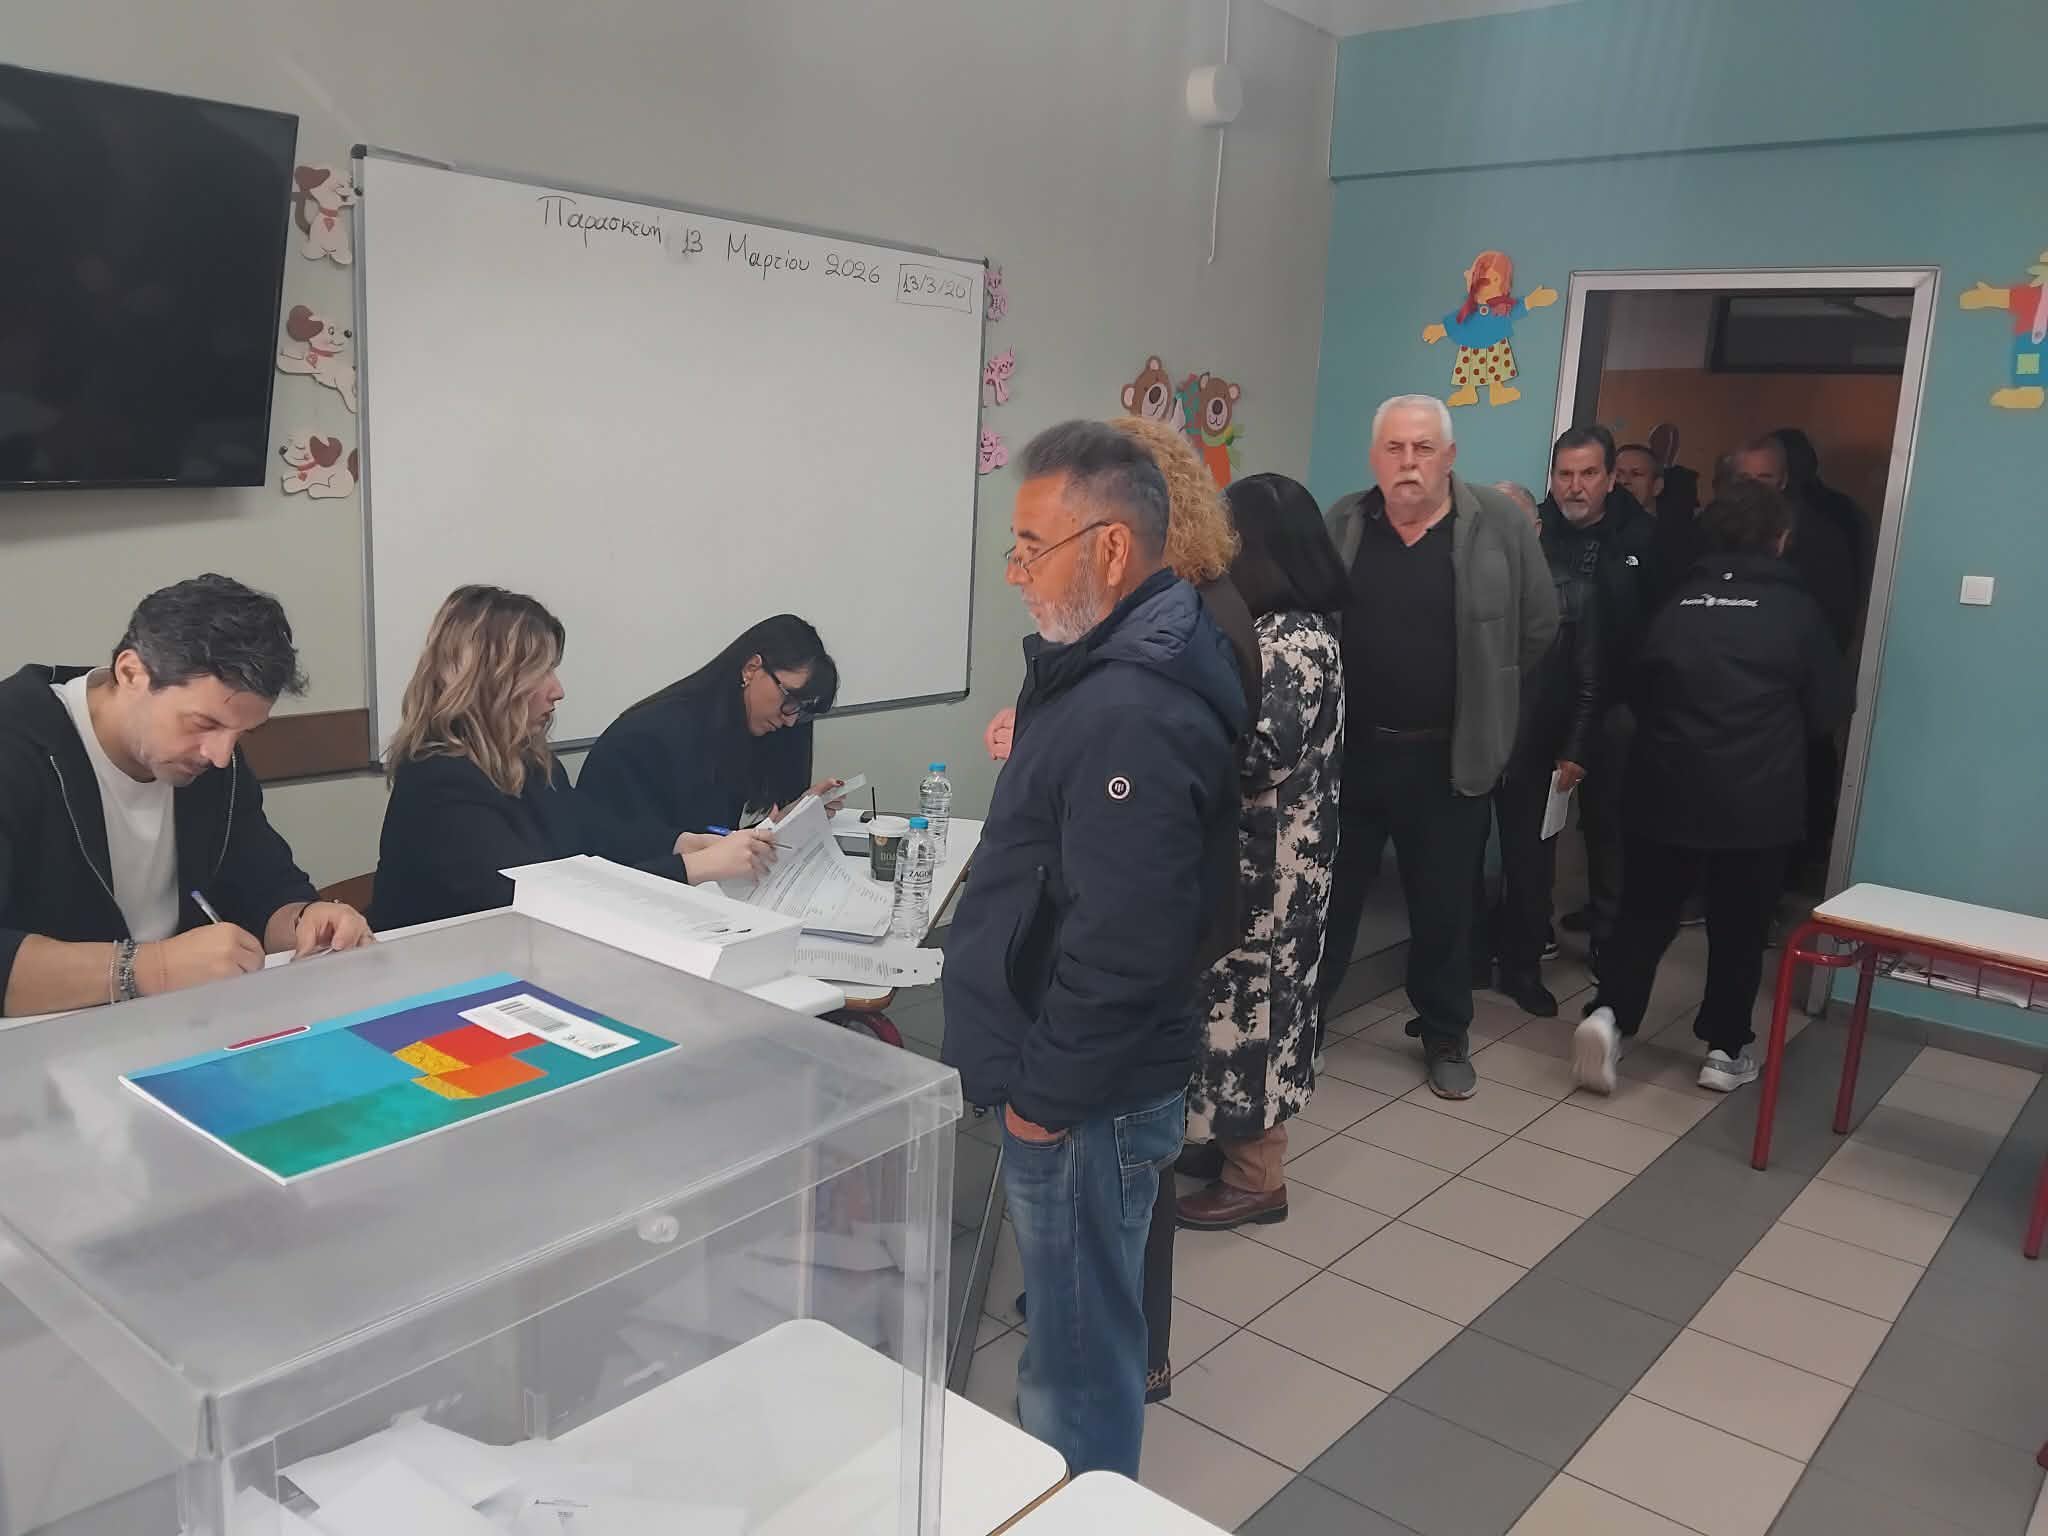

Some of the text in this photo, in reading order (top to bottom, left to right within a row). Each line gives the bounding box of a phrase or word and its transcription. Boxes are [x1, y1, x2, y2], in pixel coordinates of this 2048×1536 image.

[536, 195, 881, 284] Παρασκευή 13 Μαρτίου 2026
